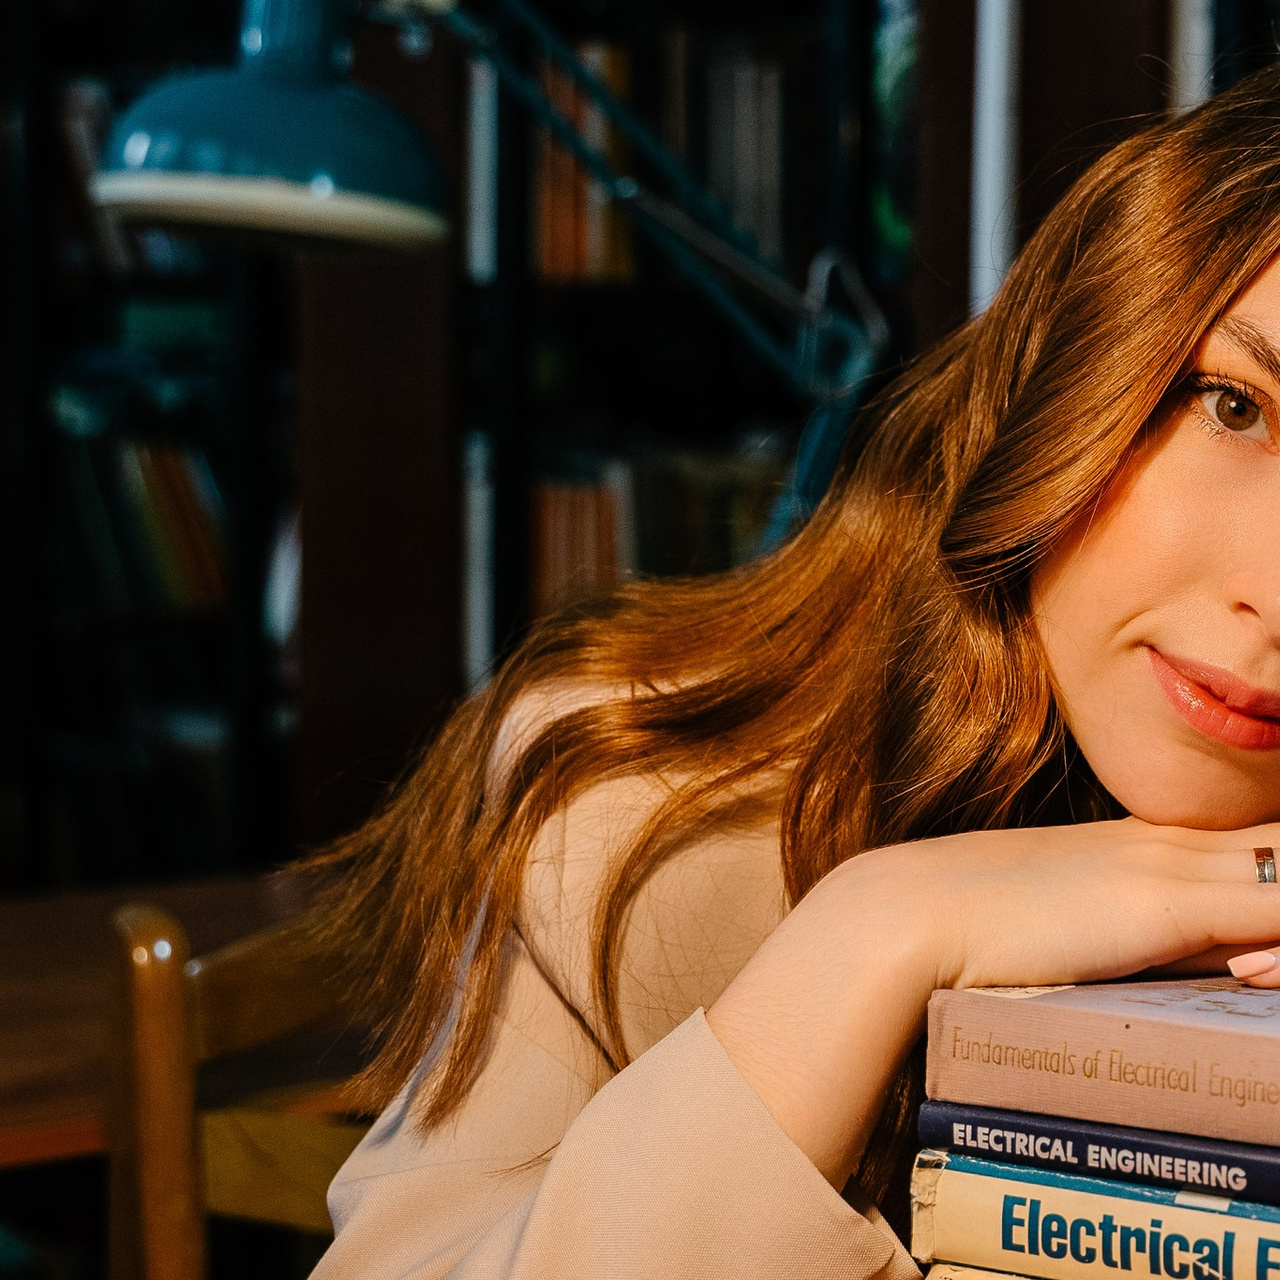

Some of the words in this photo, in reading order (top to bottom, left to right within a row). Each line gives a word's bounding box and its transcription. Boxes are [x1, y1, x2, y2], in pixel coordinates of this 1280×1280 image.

[951, 1026, 1076, 1078] Fundamentals
[1082, 1047, 1100, 1080] of
[1108, 1049, 1198, 1094] Electrical
[952, 1122, 1078, 1164] ELECTRICAL
[1087, 1144, 1248, 1192] ENGINEERING
